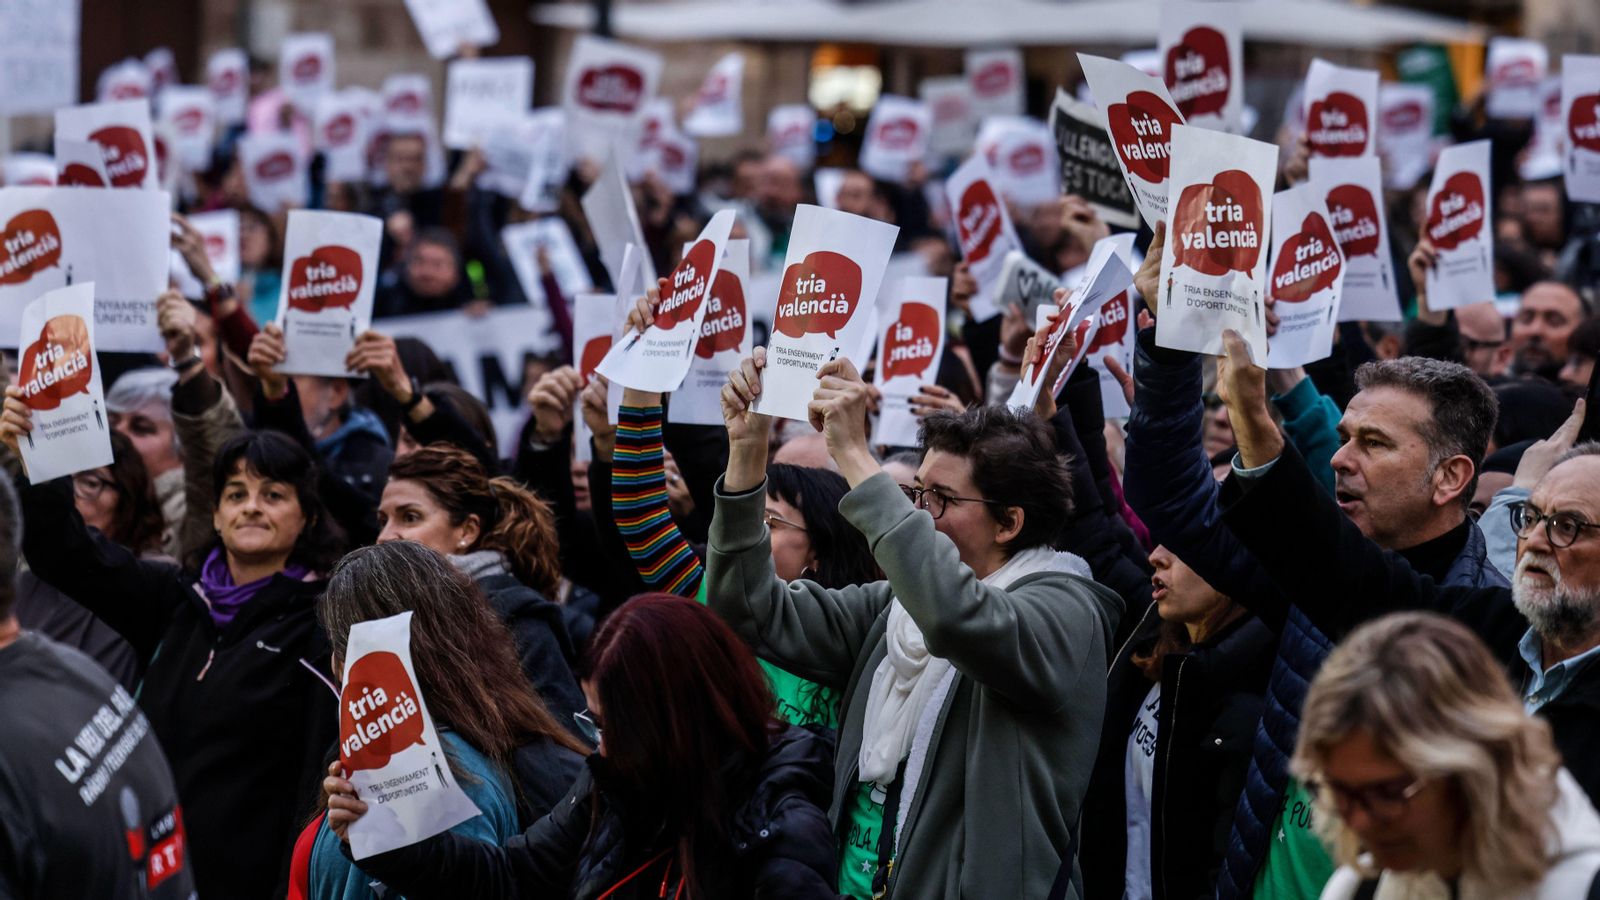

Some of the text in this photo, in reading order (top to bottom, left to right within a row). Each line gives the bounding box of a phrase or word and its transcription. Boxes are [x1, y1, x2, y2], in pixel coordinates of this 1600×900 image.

[1131, 113, 1163, 136] tria
[1122, 137, 1171, 160] valenc
[1205, 197, 1243, 223] tria
[1331, 205, 1354, 226] ria
[5, 230, 34, 254] tria
[1181, 222, 1257, 250] valencià
[1295, 237, 1324, 262] tria
[306, 261, 337, 282] tria
[674, 263, 696, 289] tria
[1275, 245, 1339, 289] valencià
[290, 273, 359, 300] valencià
[658, 275, 705, 315] valencià
[796, 273, 826, 294] tria
[1184, 285, 1201, 295] TRIA
[706, 295, 721, 314] ia
[778, 293, 849, 318] valencià
[896, 322, 912, 342] ia
[35, 342, 65, 369] tria
[776, 346, 824, 360] TRIA ENSENYAMENT
[777, 357, 818, 371] D'OPORTUNITATS
[21, 349, 88, 398] valencià
[348, 686, 388, 721] tria
[341, 692, 418, 758] valencià
[54, 746, 91, 784] LA
